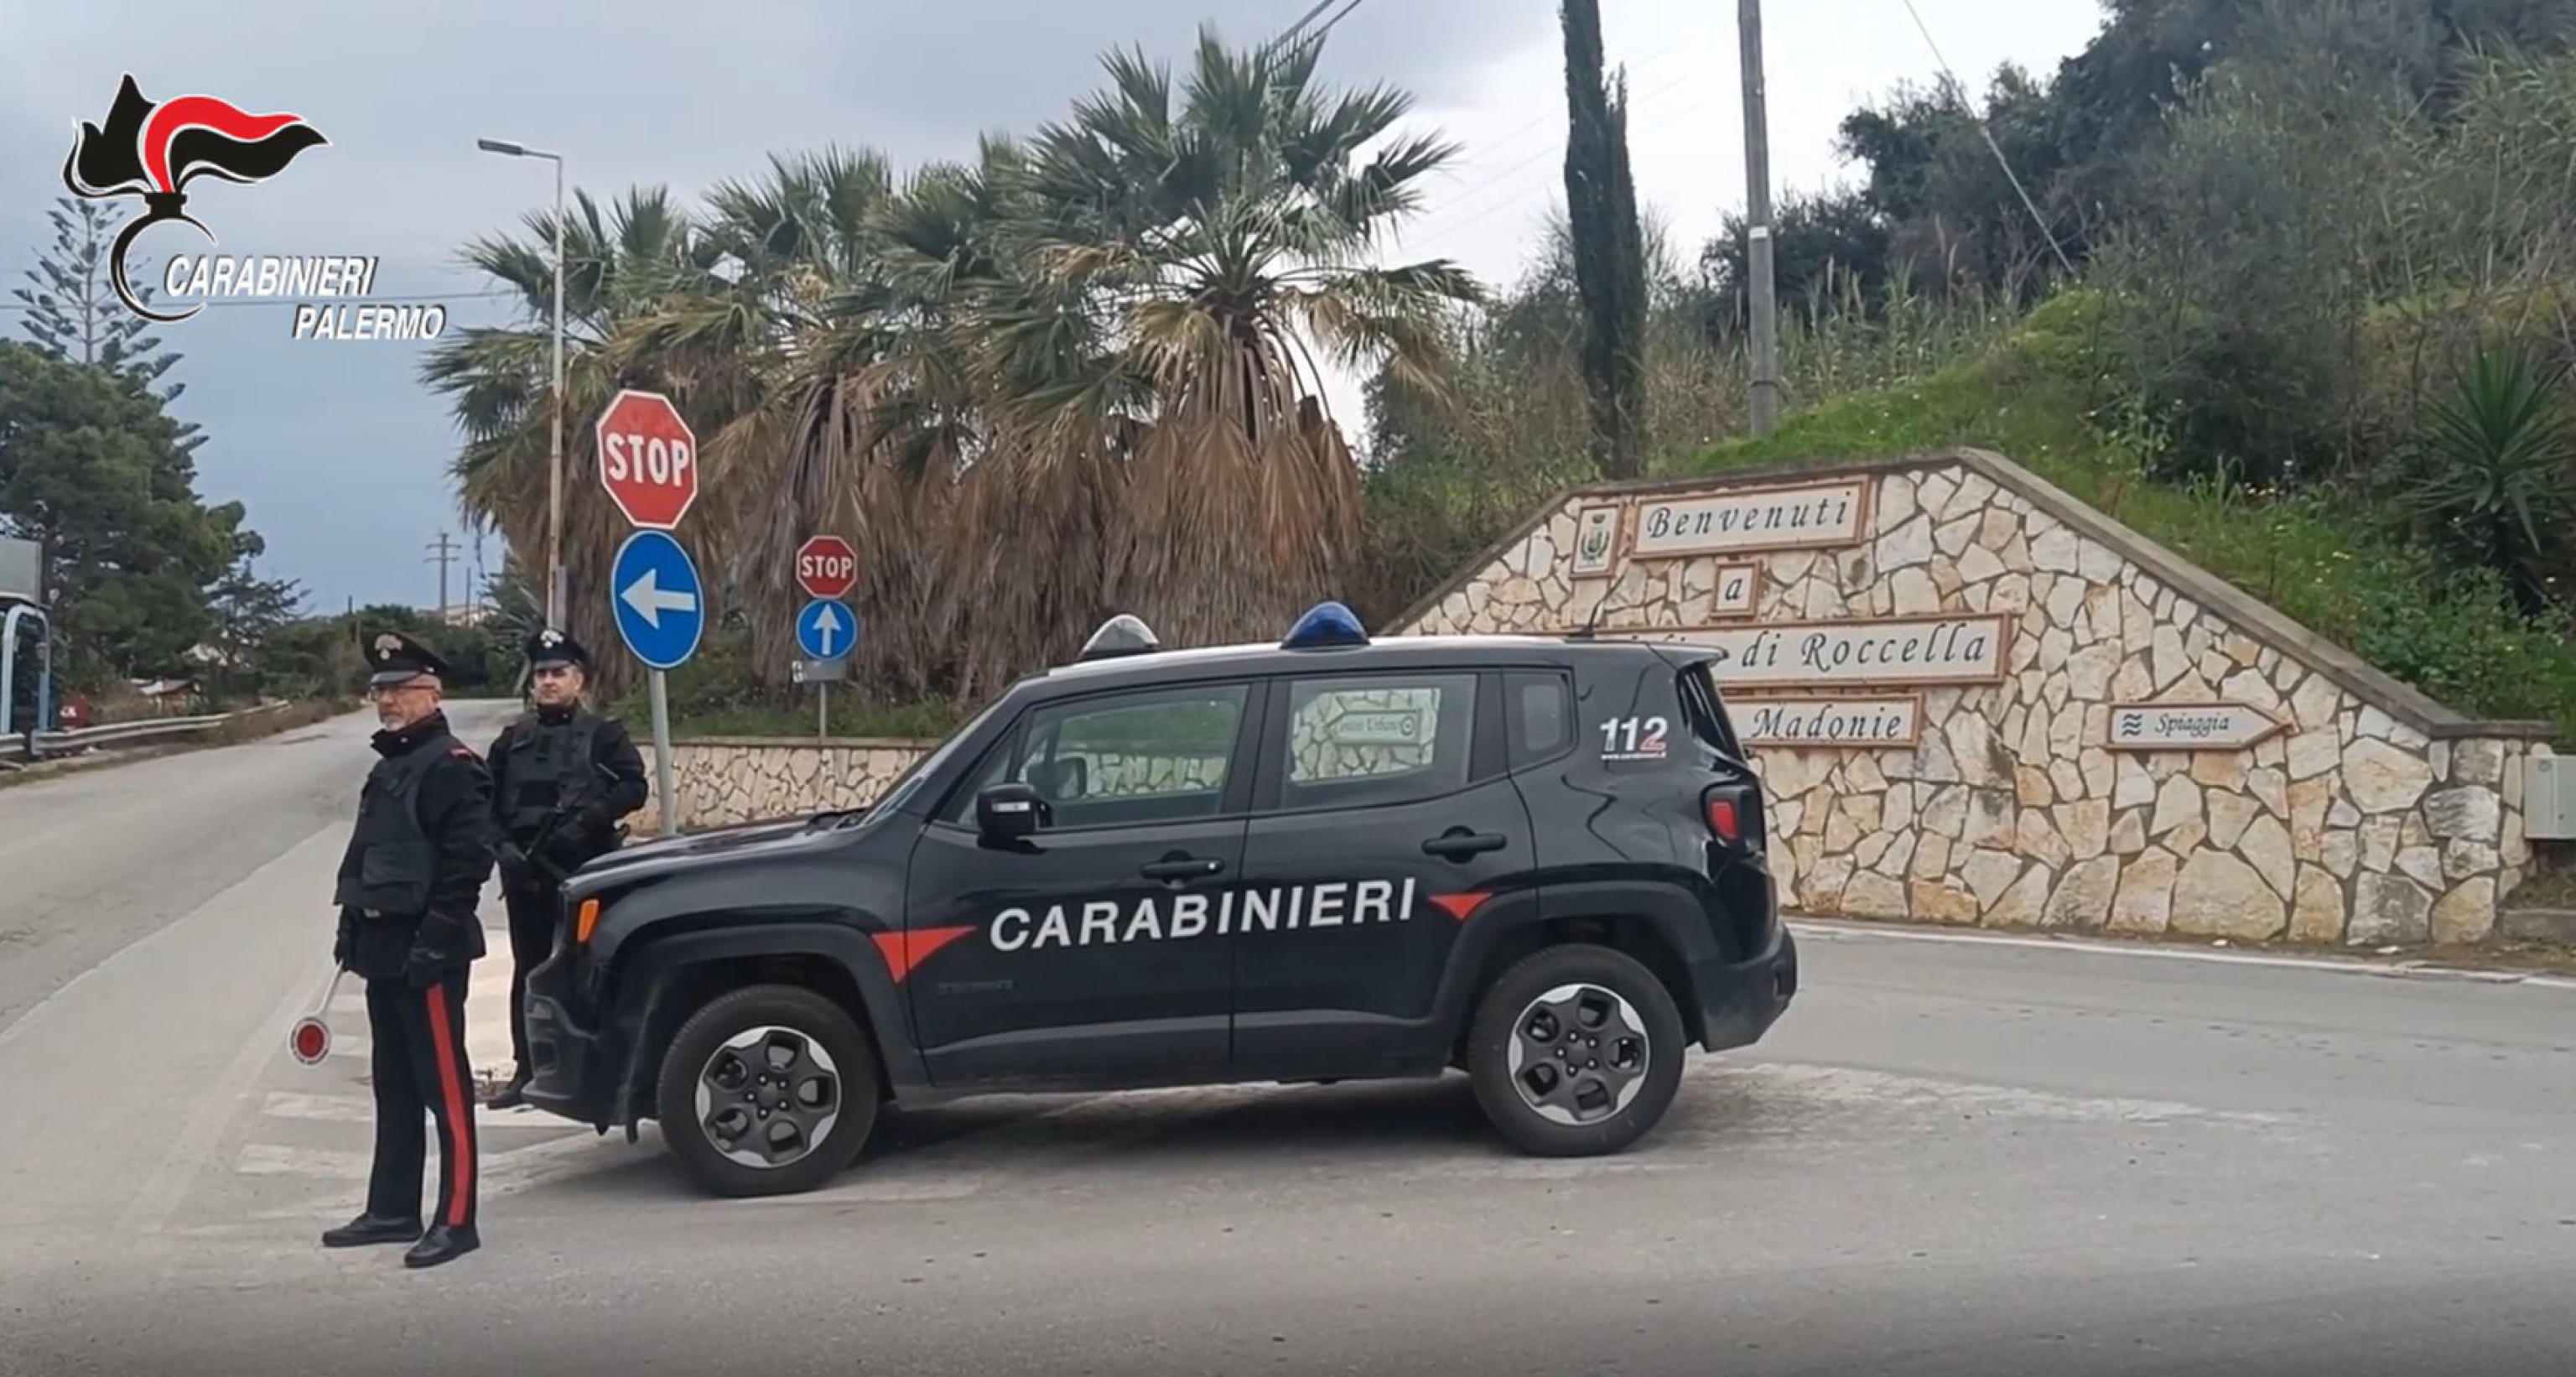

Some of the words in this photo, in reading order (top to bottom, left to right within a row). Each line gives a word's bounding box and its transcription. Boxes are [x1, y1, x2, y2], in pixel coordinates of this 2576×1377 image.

[605, 432, 690, 488] STOP
[1647, 489, 1852, 538] Benvenuti
[801, 554, 854, 579] STOP
[1724, 577, 1743, 600] a
[1741, 629, 1781, 668] di
[1801, 622, 1987, 672] Roccella
[1599, 715, 1668, 751] 112
[1750, 704, 1902, 740] Madonie
[2154, 713, 2231, 738] Spiaggia
[989, 877, 1416, 951] CARABINIERI
